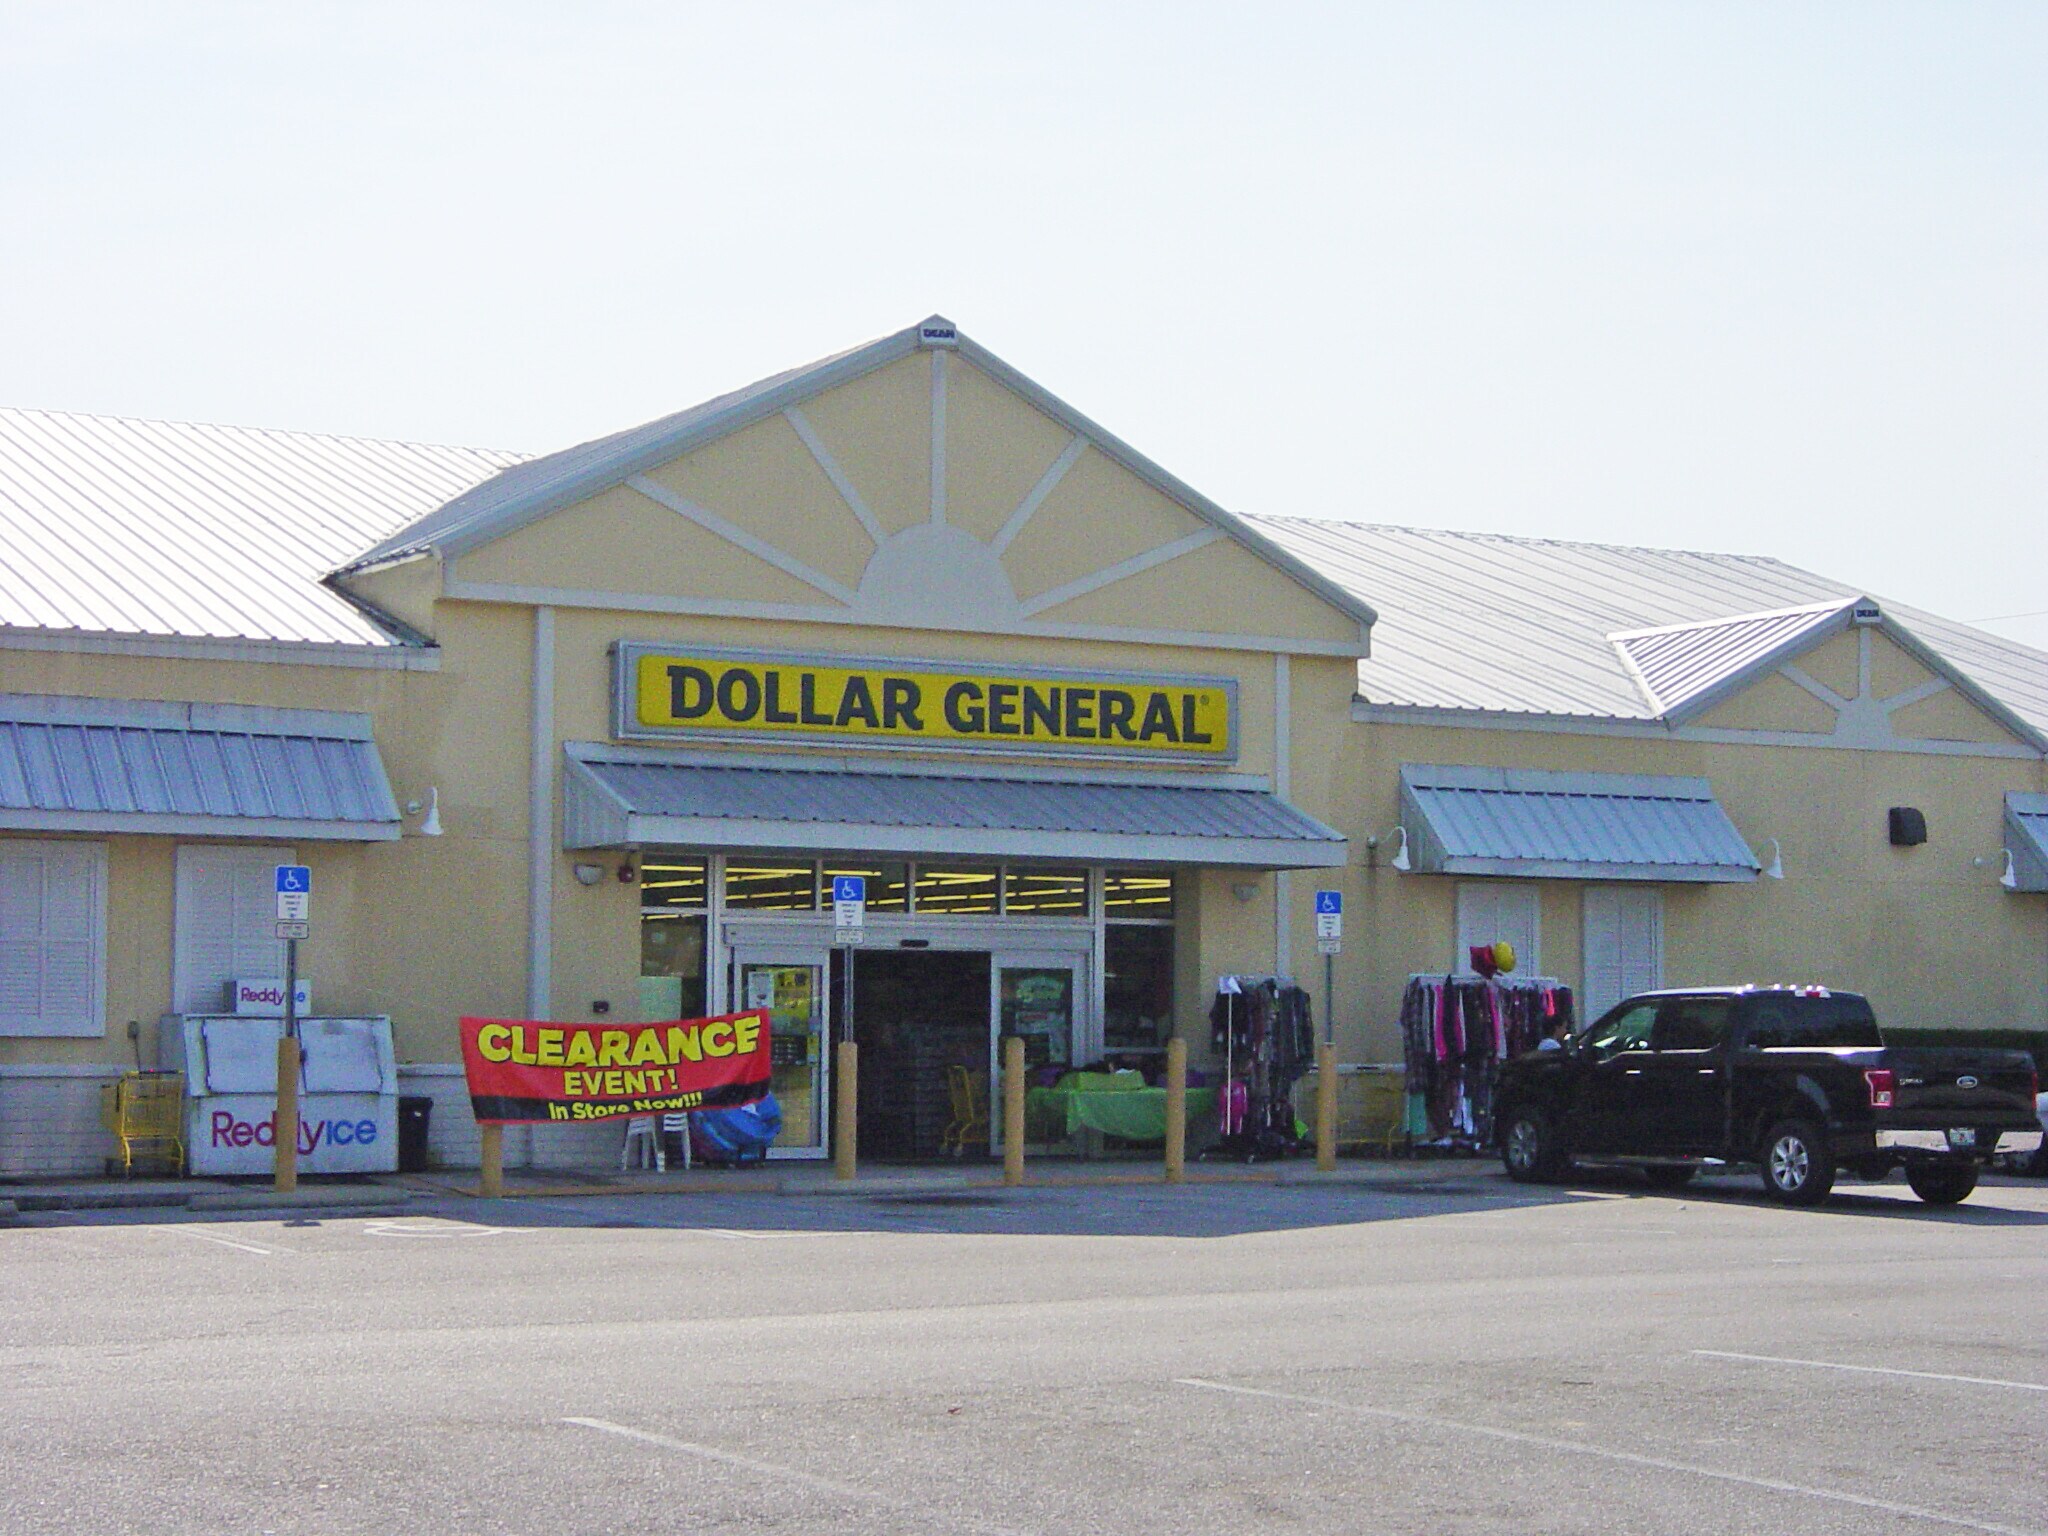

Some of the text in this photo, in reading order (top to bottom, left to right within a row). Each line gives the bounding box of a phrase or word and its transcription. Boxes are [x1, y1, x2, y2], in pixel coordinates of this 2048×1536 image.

[667, 665, 1212, 743] DOLLAR GENERAL
[477, 1015, 761, 1067] CLEARANCE
[564, 1068, 679, 1096] EVENT!
[549, 1102, 569, 1120] In
[633, 1091, 703, 1112] Now!!!
